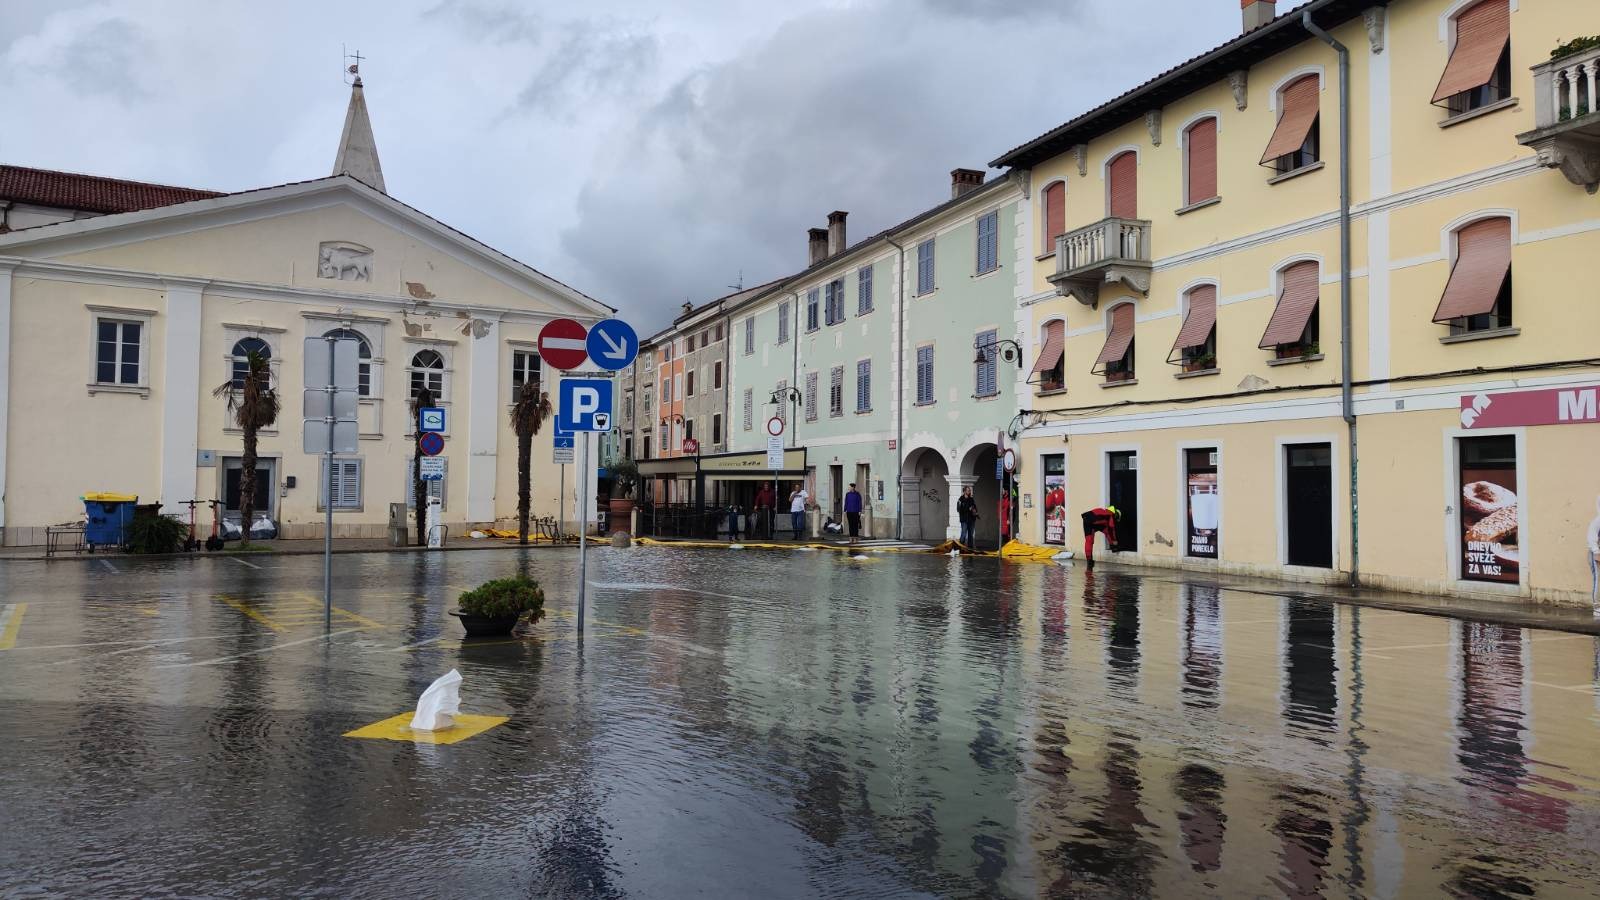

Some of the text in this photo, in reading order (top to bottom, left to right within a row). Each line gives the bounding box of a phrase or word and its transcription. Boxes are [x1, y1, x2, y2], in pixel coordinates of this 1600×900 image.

[572, 387, 599, 424] P
[1558, 389, 1600, 420] M
[683, 441, 696, 451] illy
[1191, 535, 1208, 544] ZNANO
[1191, 544, 1214, 553] POREKLO
[1468, 541, 1502, 551] DNEVNO
[1468, 551, 1495, 563] SVEŽE
[1468, 564, 1502, 576] ZA VAS!
